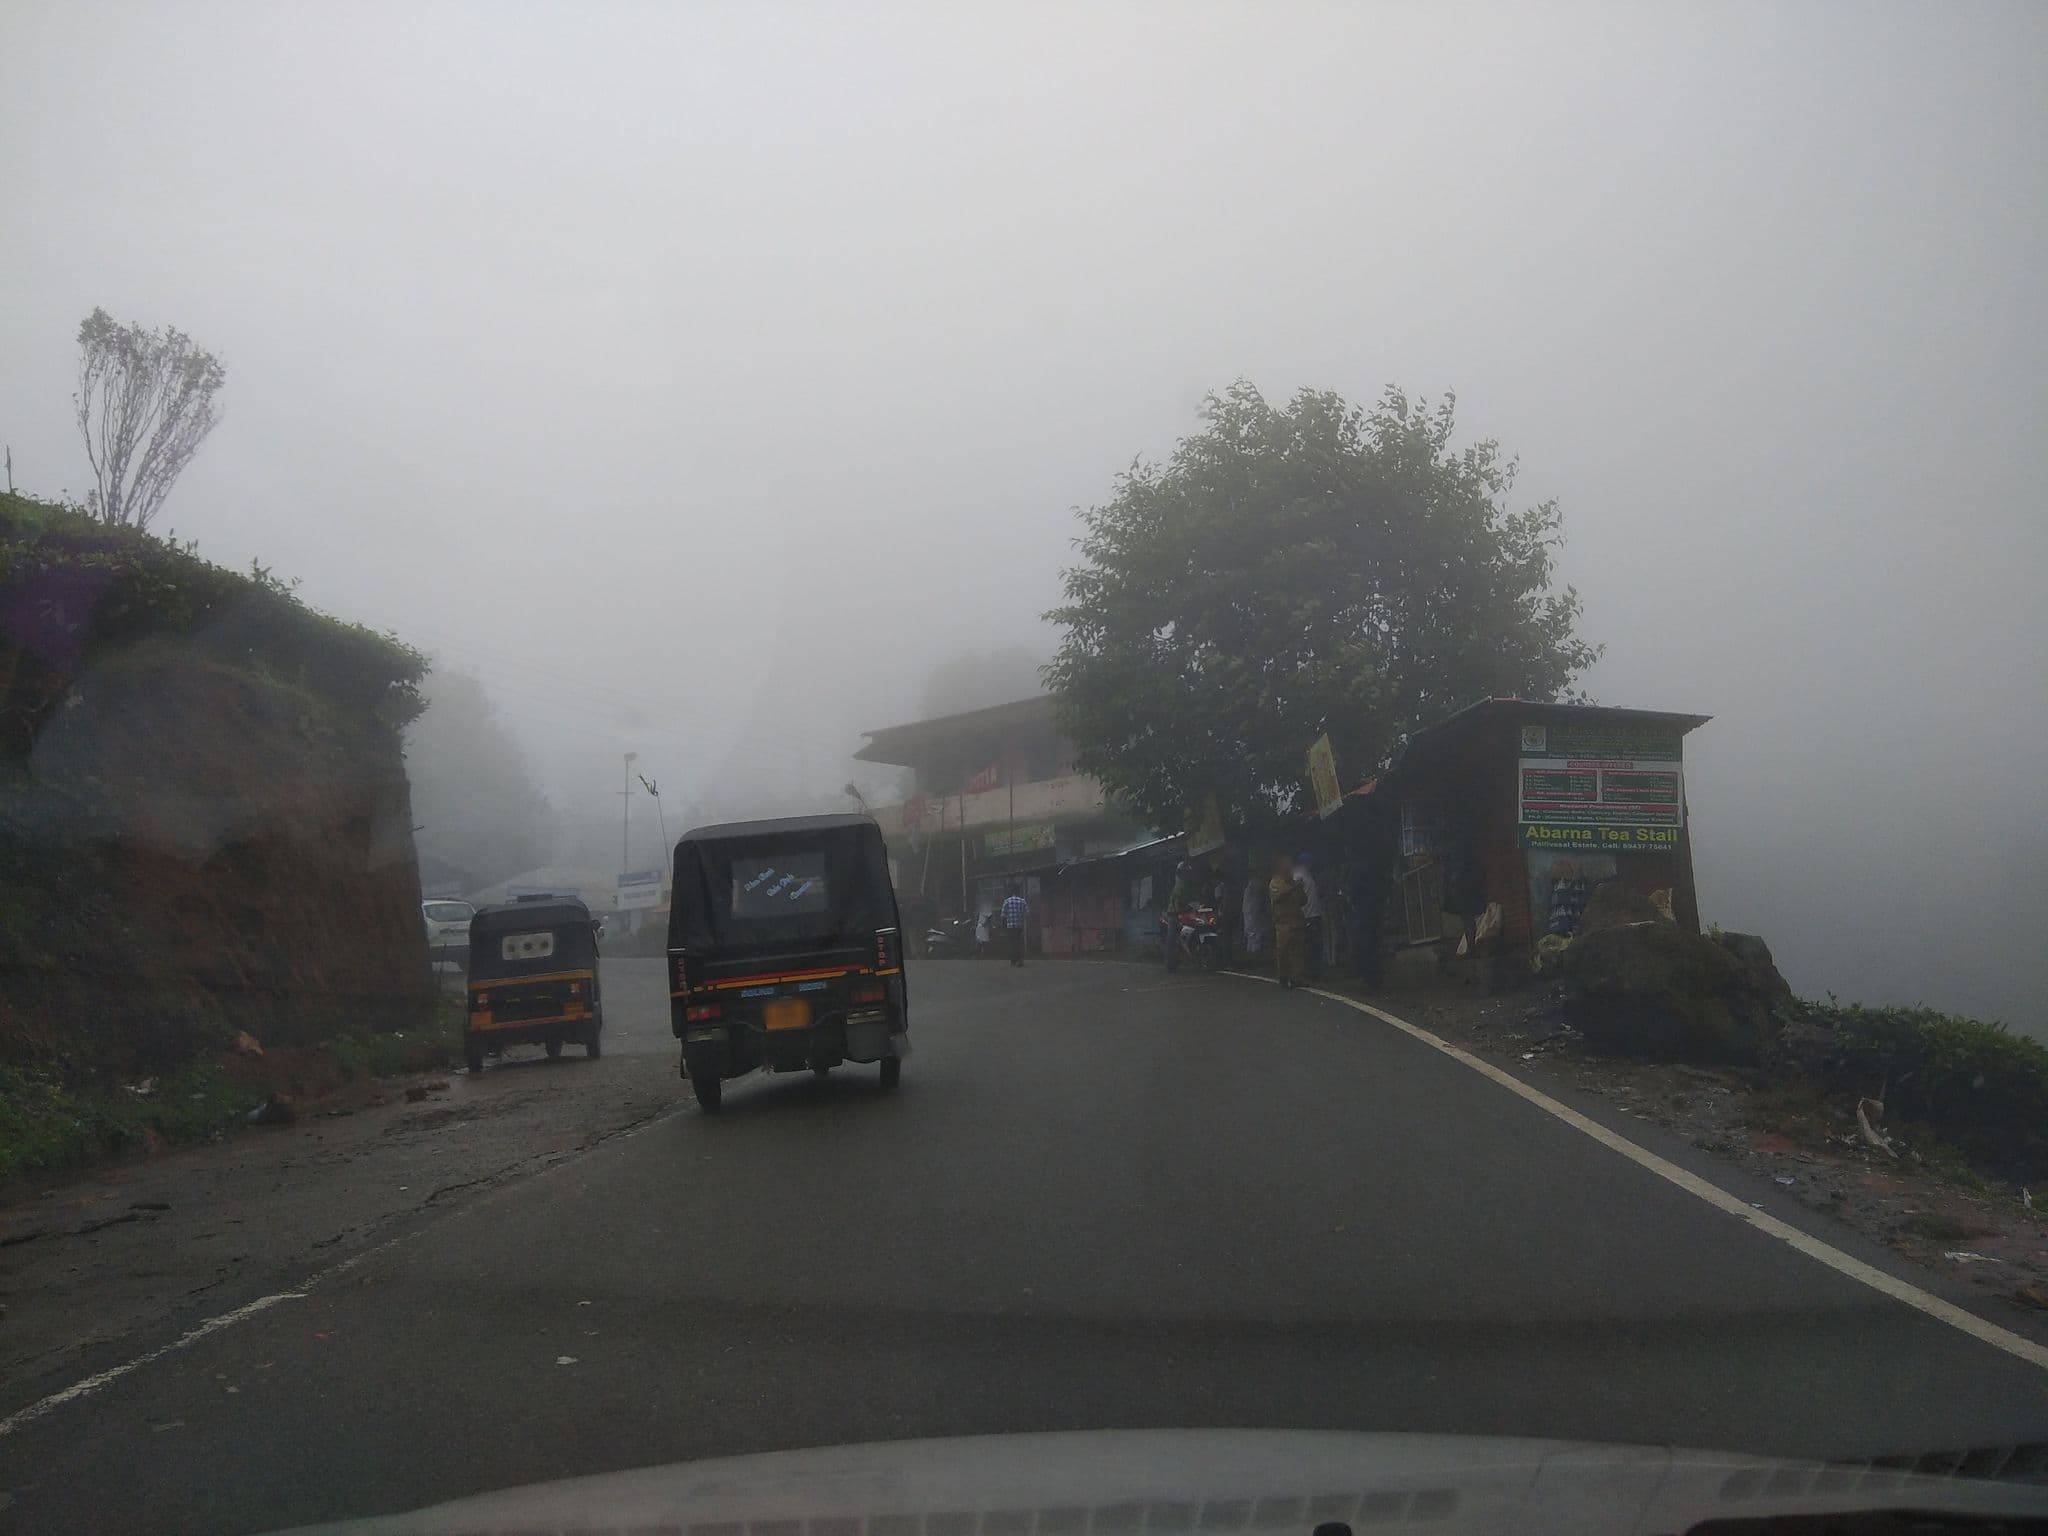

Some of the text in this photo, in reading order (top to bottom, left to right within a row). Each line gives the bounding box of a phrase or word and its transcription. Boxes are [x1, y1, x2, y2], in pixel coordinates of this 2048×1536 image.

[1526, 826, 1678, 842] Abarna Tea Stall
